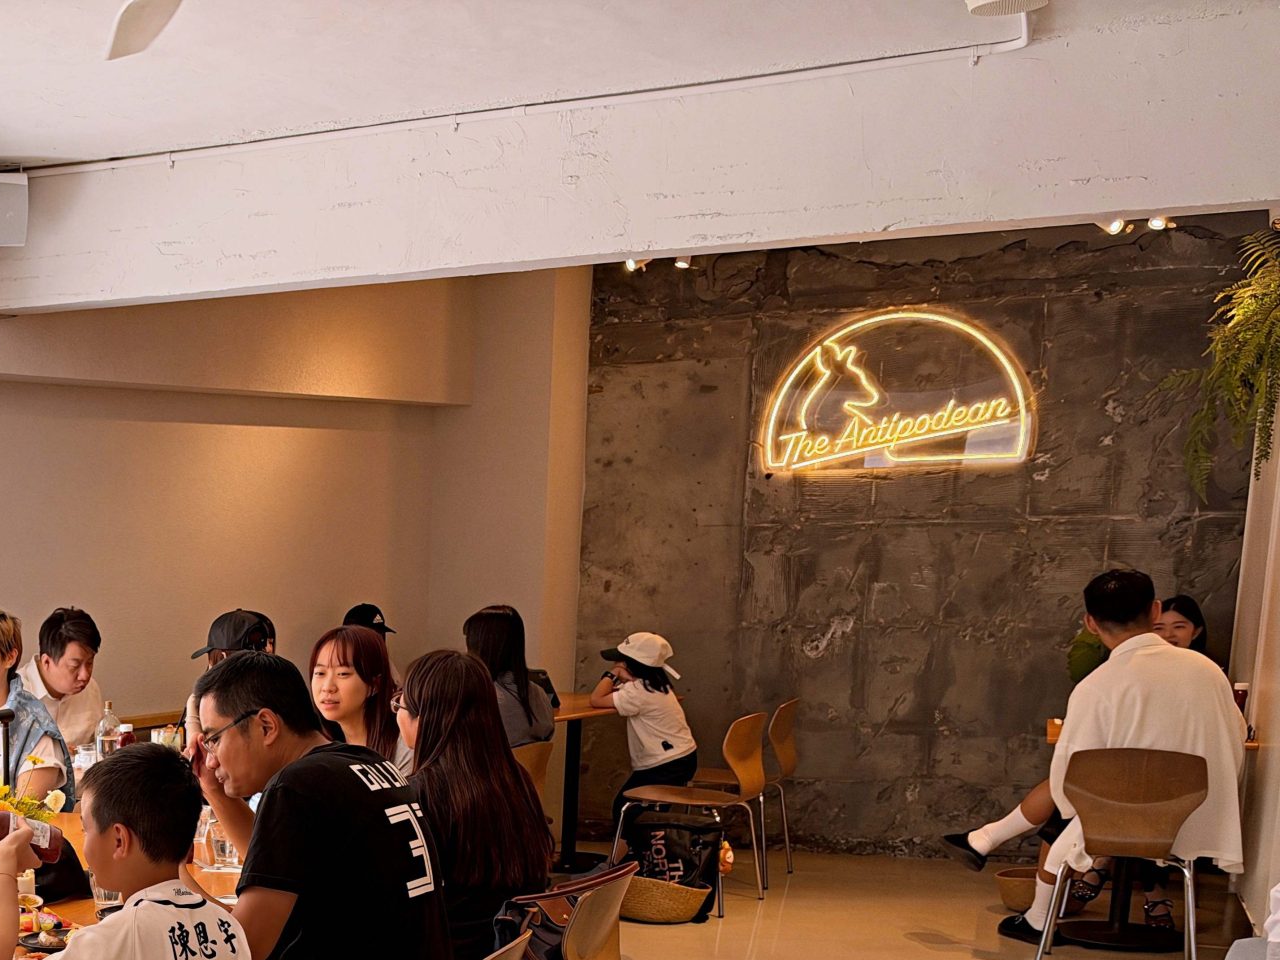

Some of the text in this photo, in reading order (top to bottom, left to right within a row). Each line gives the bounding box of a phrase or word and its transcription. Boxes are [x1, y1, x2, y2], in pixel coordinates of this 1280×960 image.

[779, 397, 1012, 465] The Antipodean
[384, 802, 435, 899] 3
[650, 830, 670, 883] NORT
